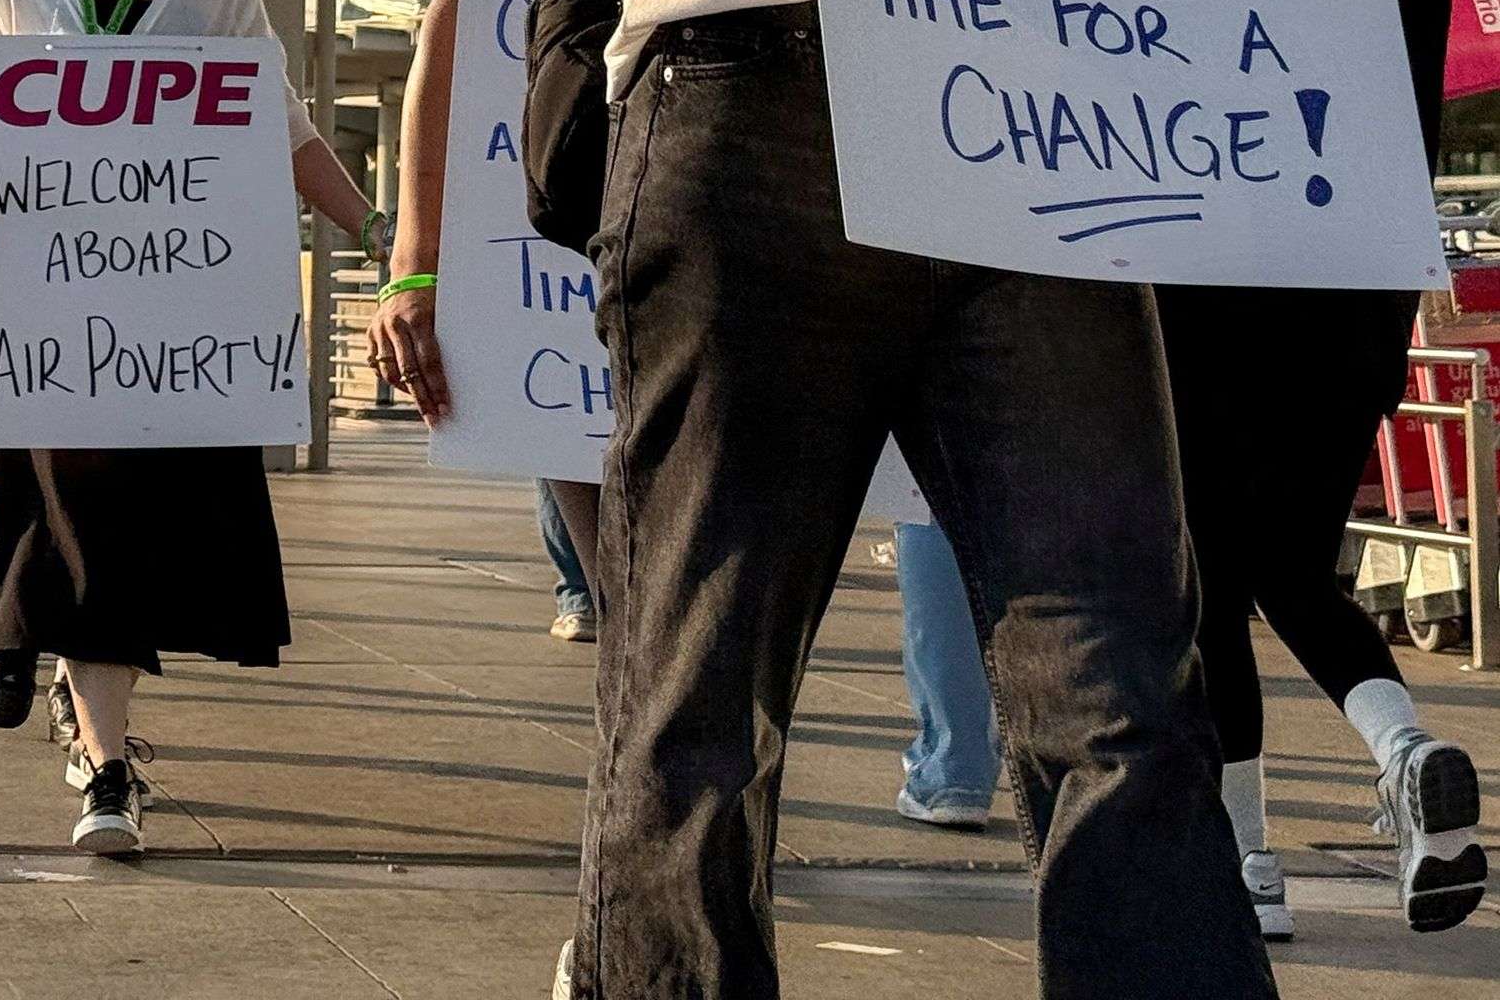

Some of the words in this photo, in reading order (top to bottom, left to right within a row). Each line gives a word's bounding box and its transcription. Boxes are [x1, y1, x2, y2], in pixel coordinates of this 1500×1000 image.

[1239, 10, 1290, 74] A
[942, 65, 1333, 207] CHANGE!
[47, 228, 232, 282] ABOARD
[87, 313, 301, 398] POVERTY!
